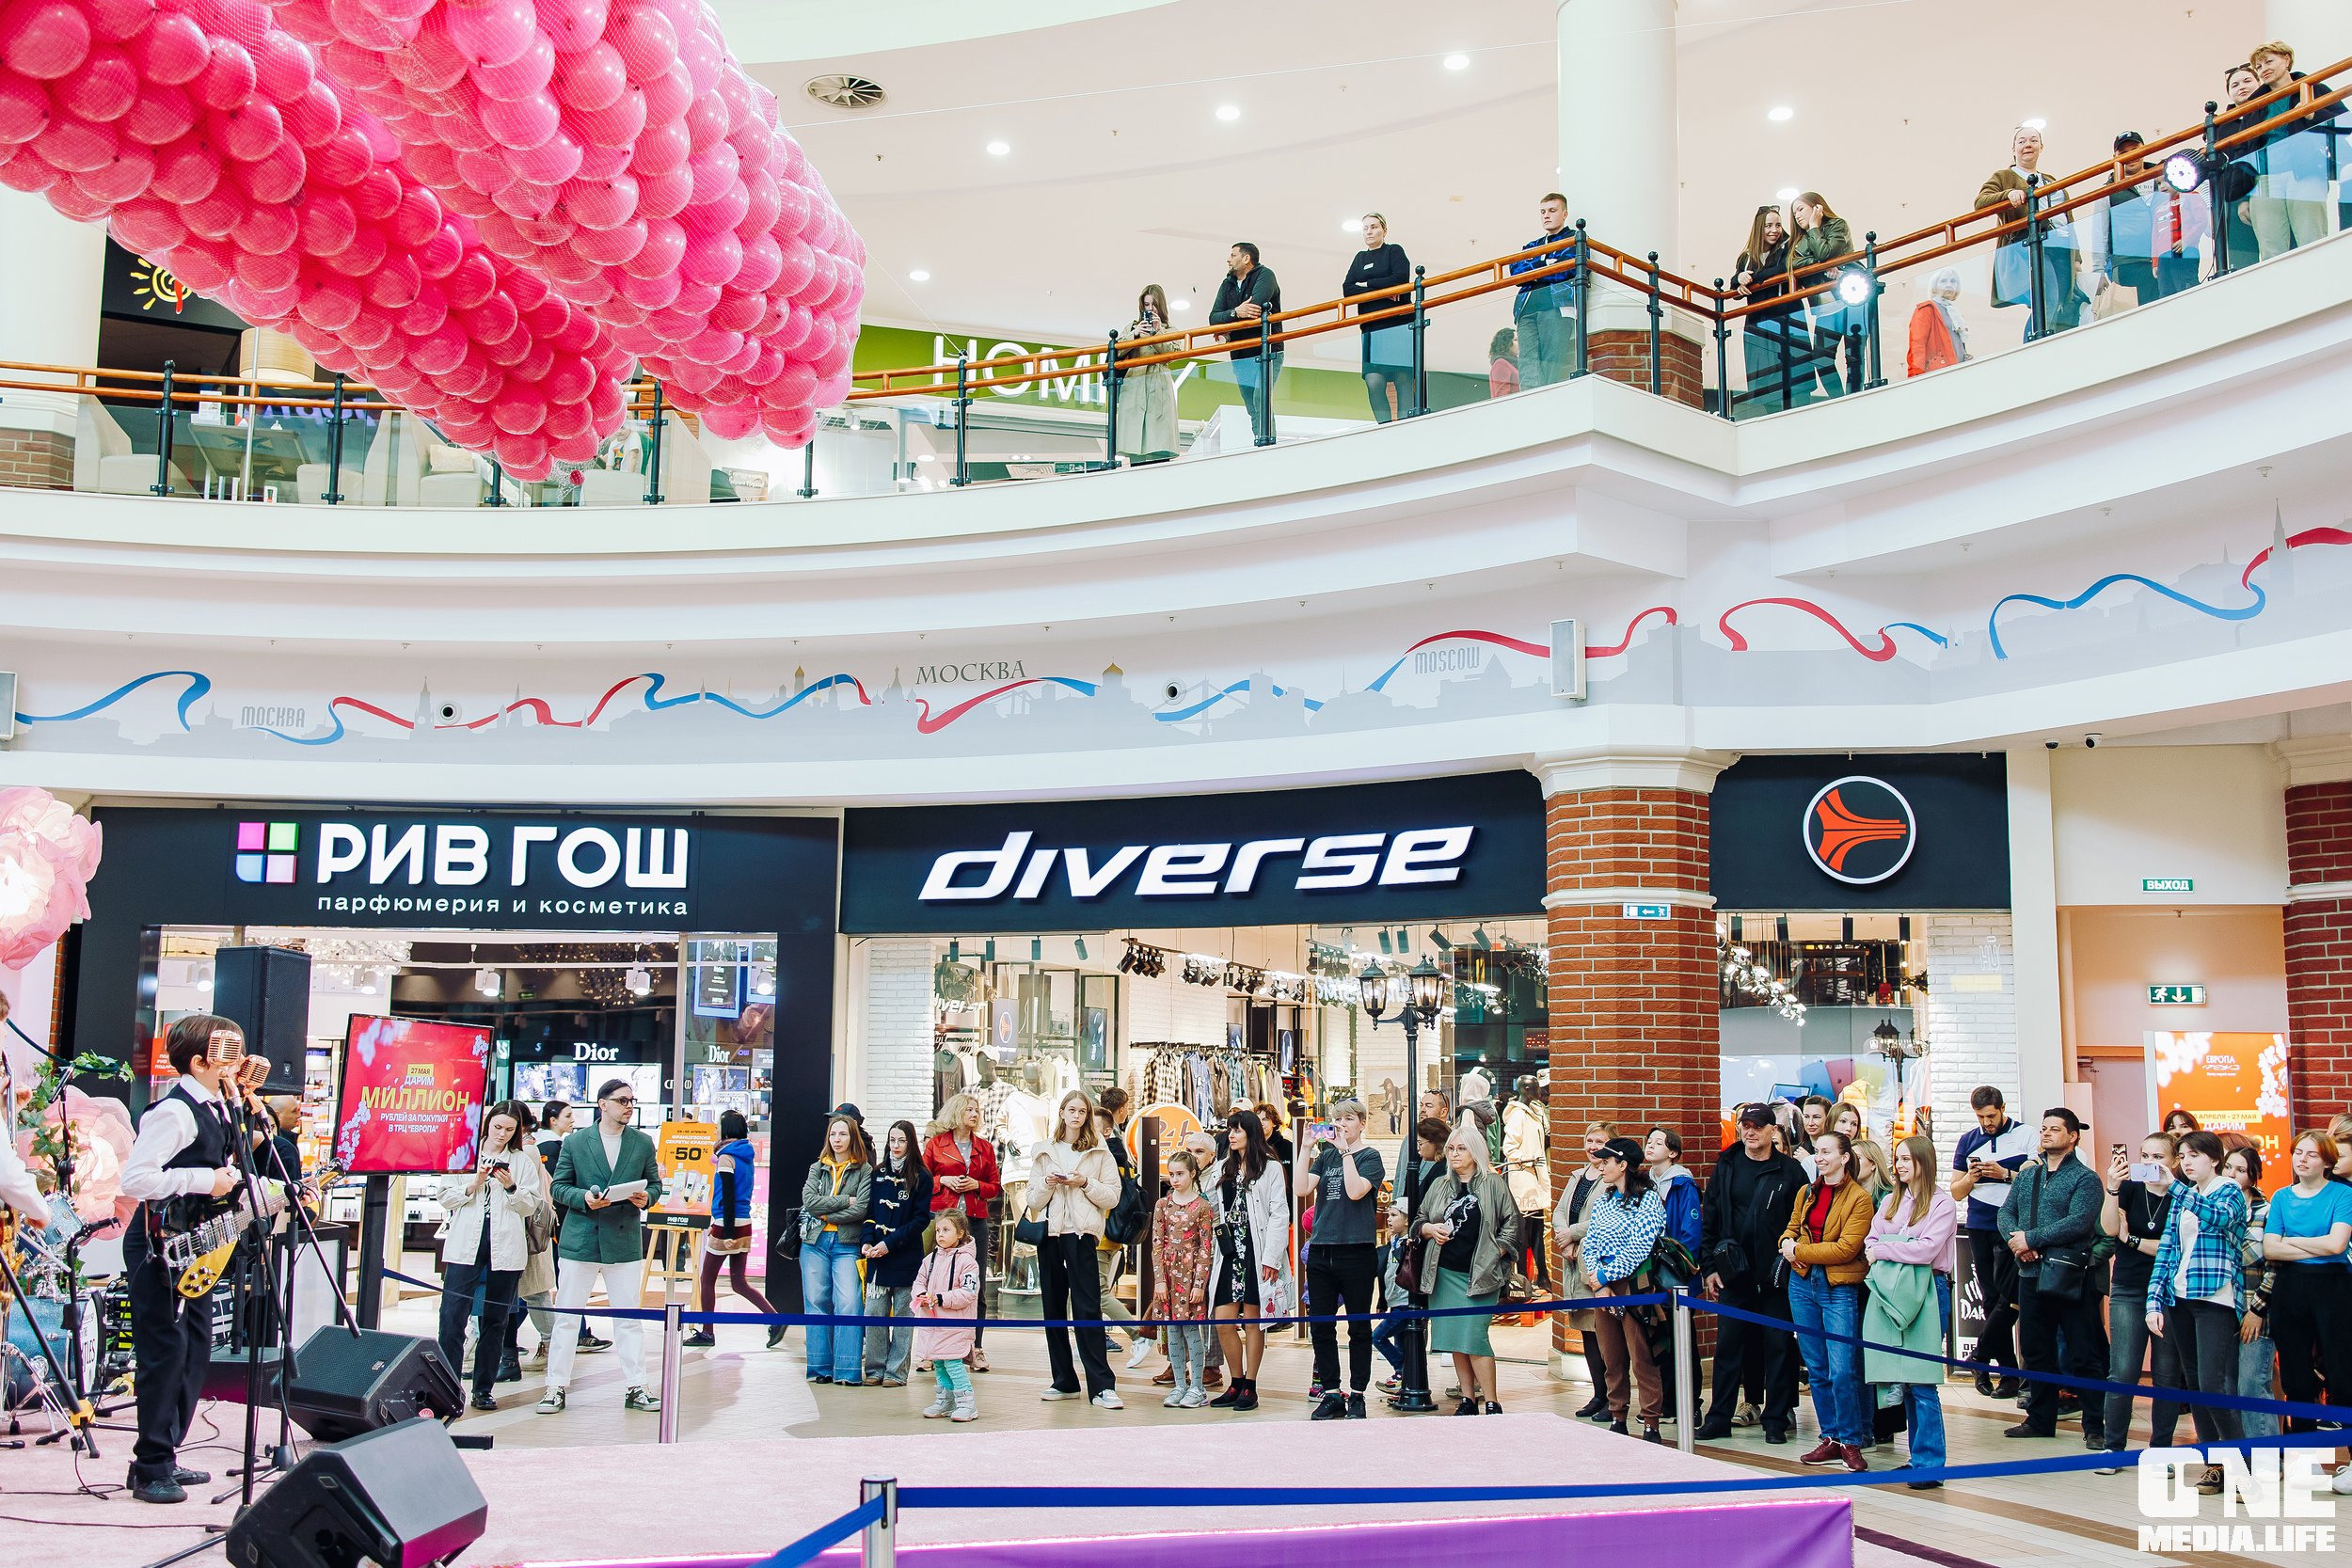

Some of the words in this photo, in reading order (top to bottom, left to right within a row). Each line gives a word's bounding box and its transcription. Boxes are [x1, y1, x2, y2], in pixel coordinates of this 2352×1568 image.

[1414, 646, 1480, 675] MOSCOW
[915, 659, 1027, 685] МОСКВА
[317, 822, 490, 886] РИВ
[511, 827, 690, 889] ГОШ
[918, 826, 1474, 900] diverse
[2147, 880, 2190, 891] ВЫХОД
[317, 895, 501, 916] парфюмерия
[513, 899, 527, 913] и
[539, 899, 688, 916] косметика
[573, 1042, 619, 1061] Dior
[708, 1045, 730, 1063] Dior
[2206, 1055, 2235, 1064] ЕВРОПА
[404, 1076, 435, 1086] ДАРИМ
[361, 1086, 469, 1112] МИЛЛИОН
[380, 1112, 407, 1122] РУБЛЕЙ
[418, 1115, 449, 1123] ПОКУПКИ
[394, 1125, 407, 1134] ТРЦ
[2202, 1122, 2246, 1132] ДАРИМ
[898, 1190, 910, 1200] 95
